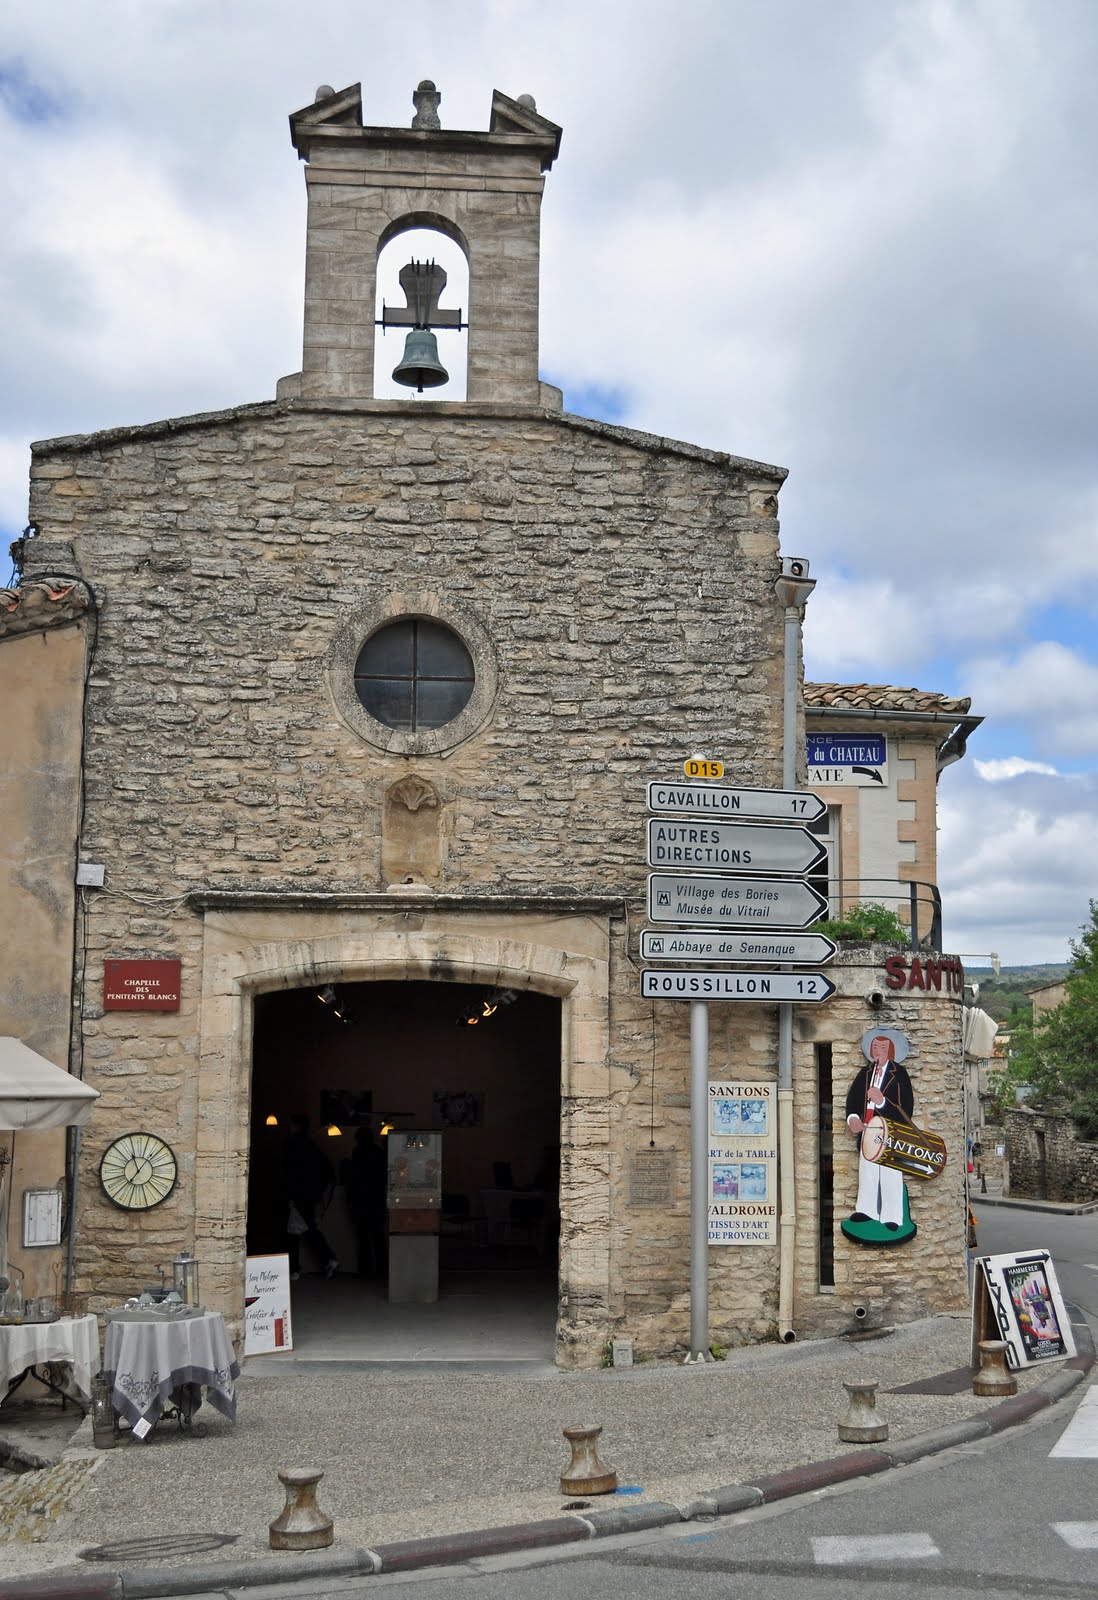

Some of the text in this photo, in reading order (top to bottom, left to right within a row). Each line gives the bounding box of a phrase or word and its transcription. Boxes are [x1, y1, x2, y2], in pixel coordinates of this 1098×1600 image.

[814, 746, 825, 761] du
[829, 746, 880, 762] CHATEAU
[690, 762, 719, 776] D15
[657, 791, 807, 814] CAVAILLON 17
[657, 827, 720, 844] AUTRES
[656, 846, 752, 863] DIRECTIONS
[676, 885, 779, 901] Village des Bories
[676, 903, 770, 917] Musée du Vitrail
[670, 940, 796, 956] Abbaye de Senanque
[649, 977, 817, 994] ROUSSILLON 12
[709, 1086, 770, 1097] SANTONS
[707, 1150, 776, 1158] RT de la TABLE
[874, 1133, 944, 1164] SANTONS
[709, 1220, 770, 1229] TISSUS D'ART
[708, 1232, 770, 1240] DE PROVENCE
